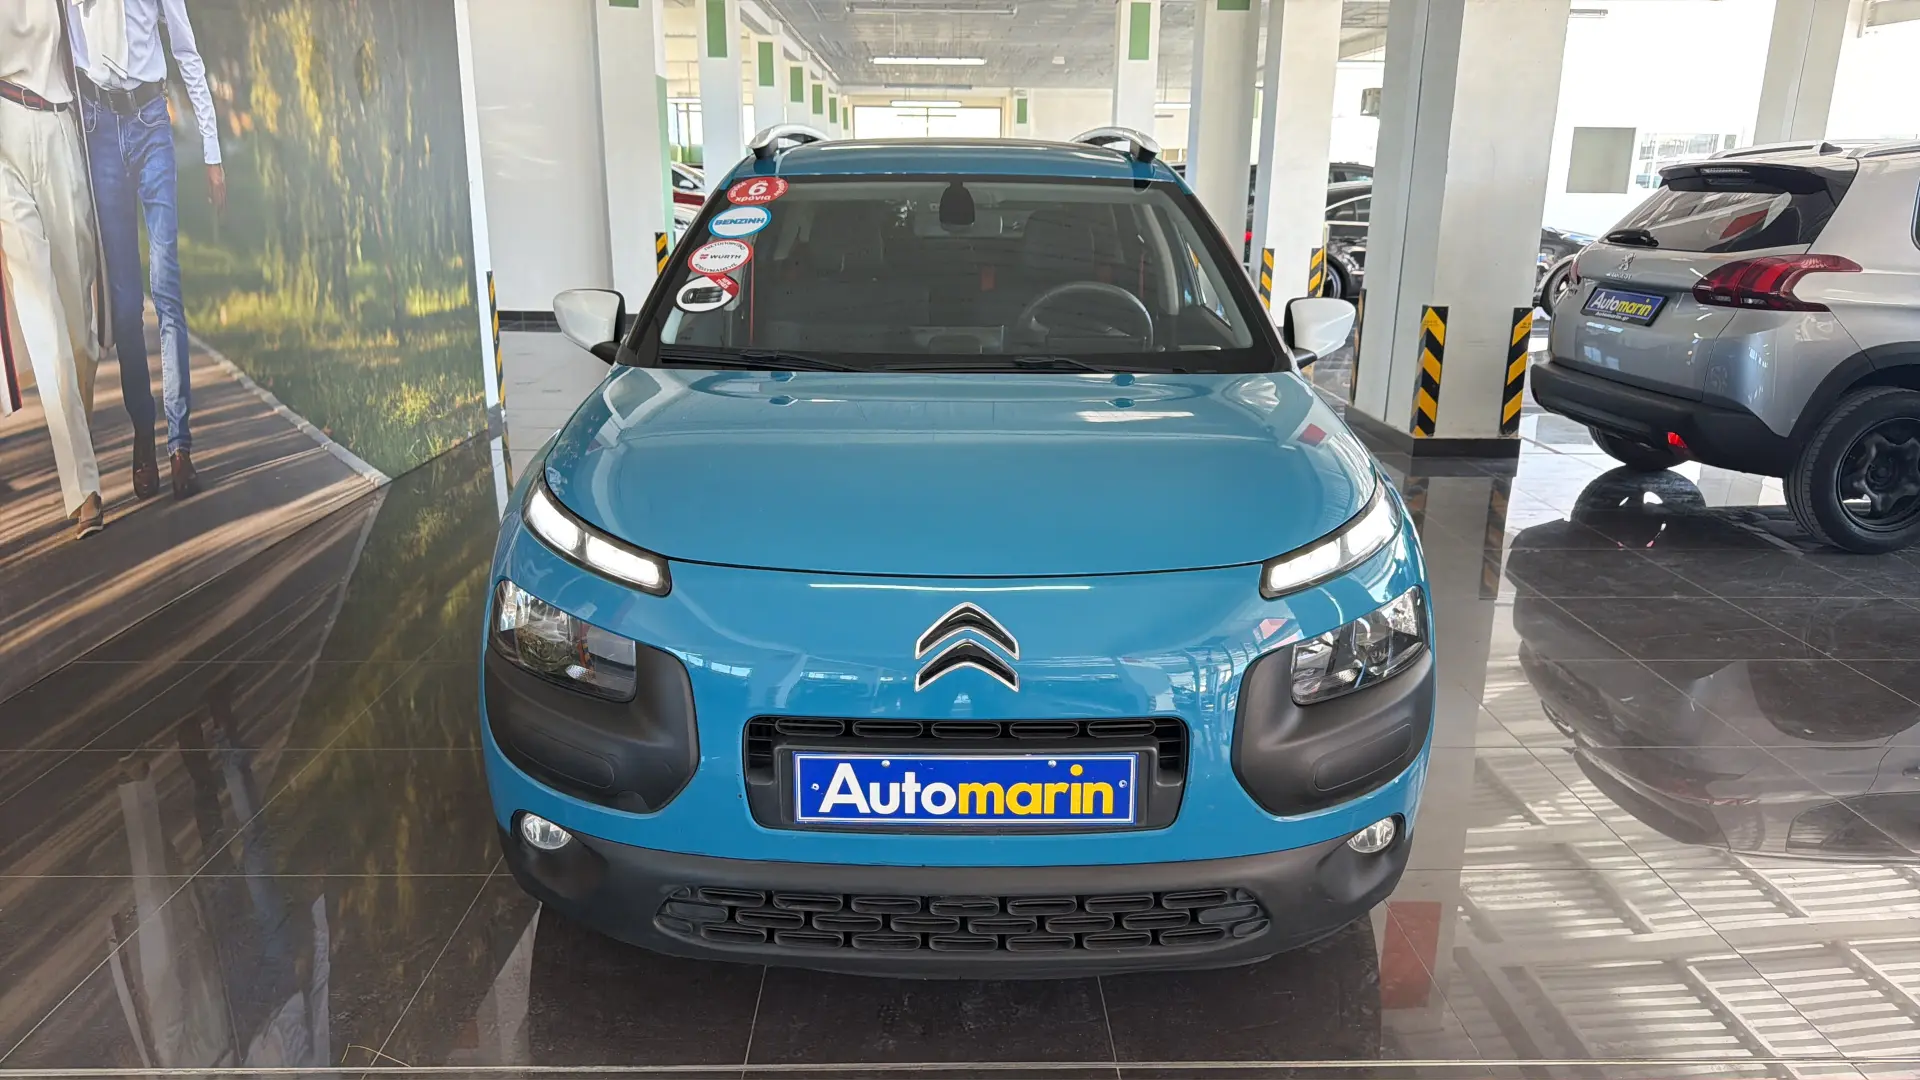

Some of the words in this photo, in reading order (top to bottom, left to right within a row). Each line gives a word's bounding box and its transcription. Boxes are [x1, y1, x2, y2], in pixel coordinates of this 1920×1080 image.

[748, 182, 769, 196] 6
[1590, 292, 1652, 317] Automarin
[818, 762, 1114, 816] Automarin
